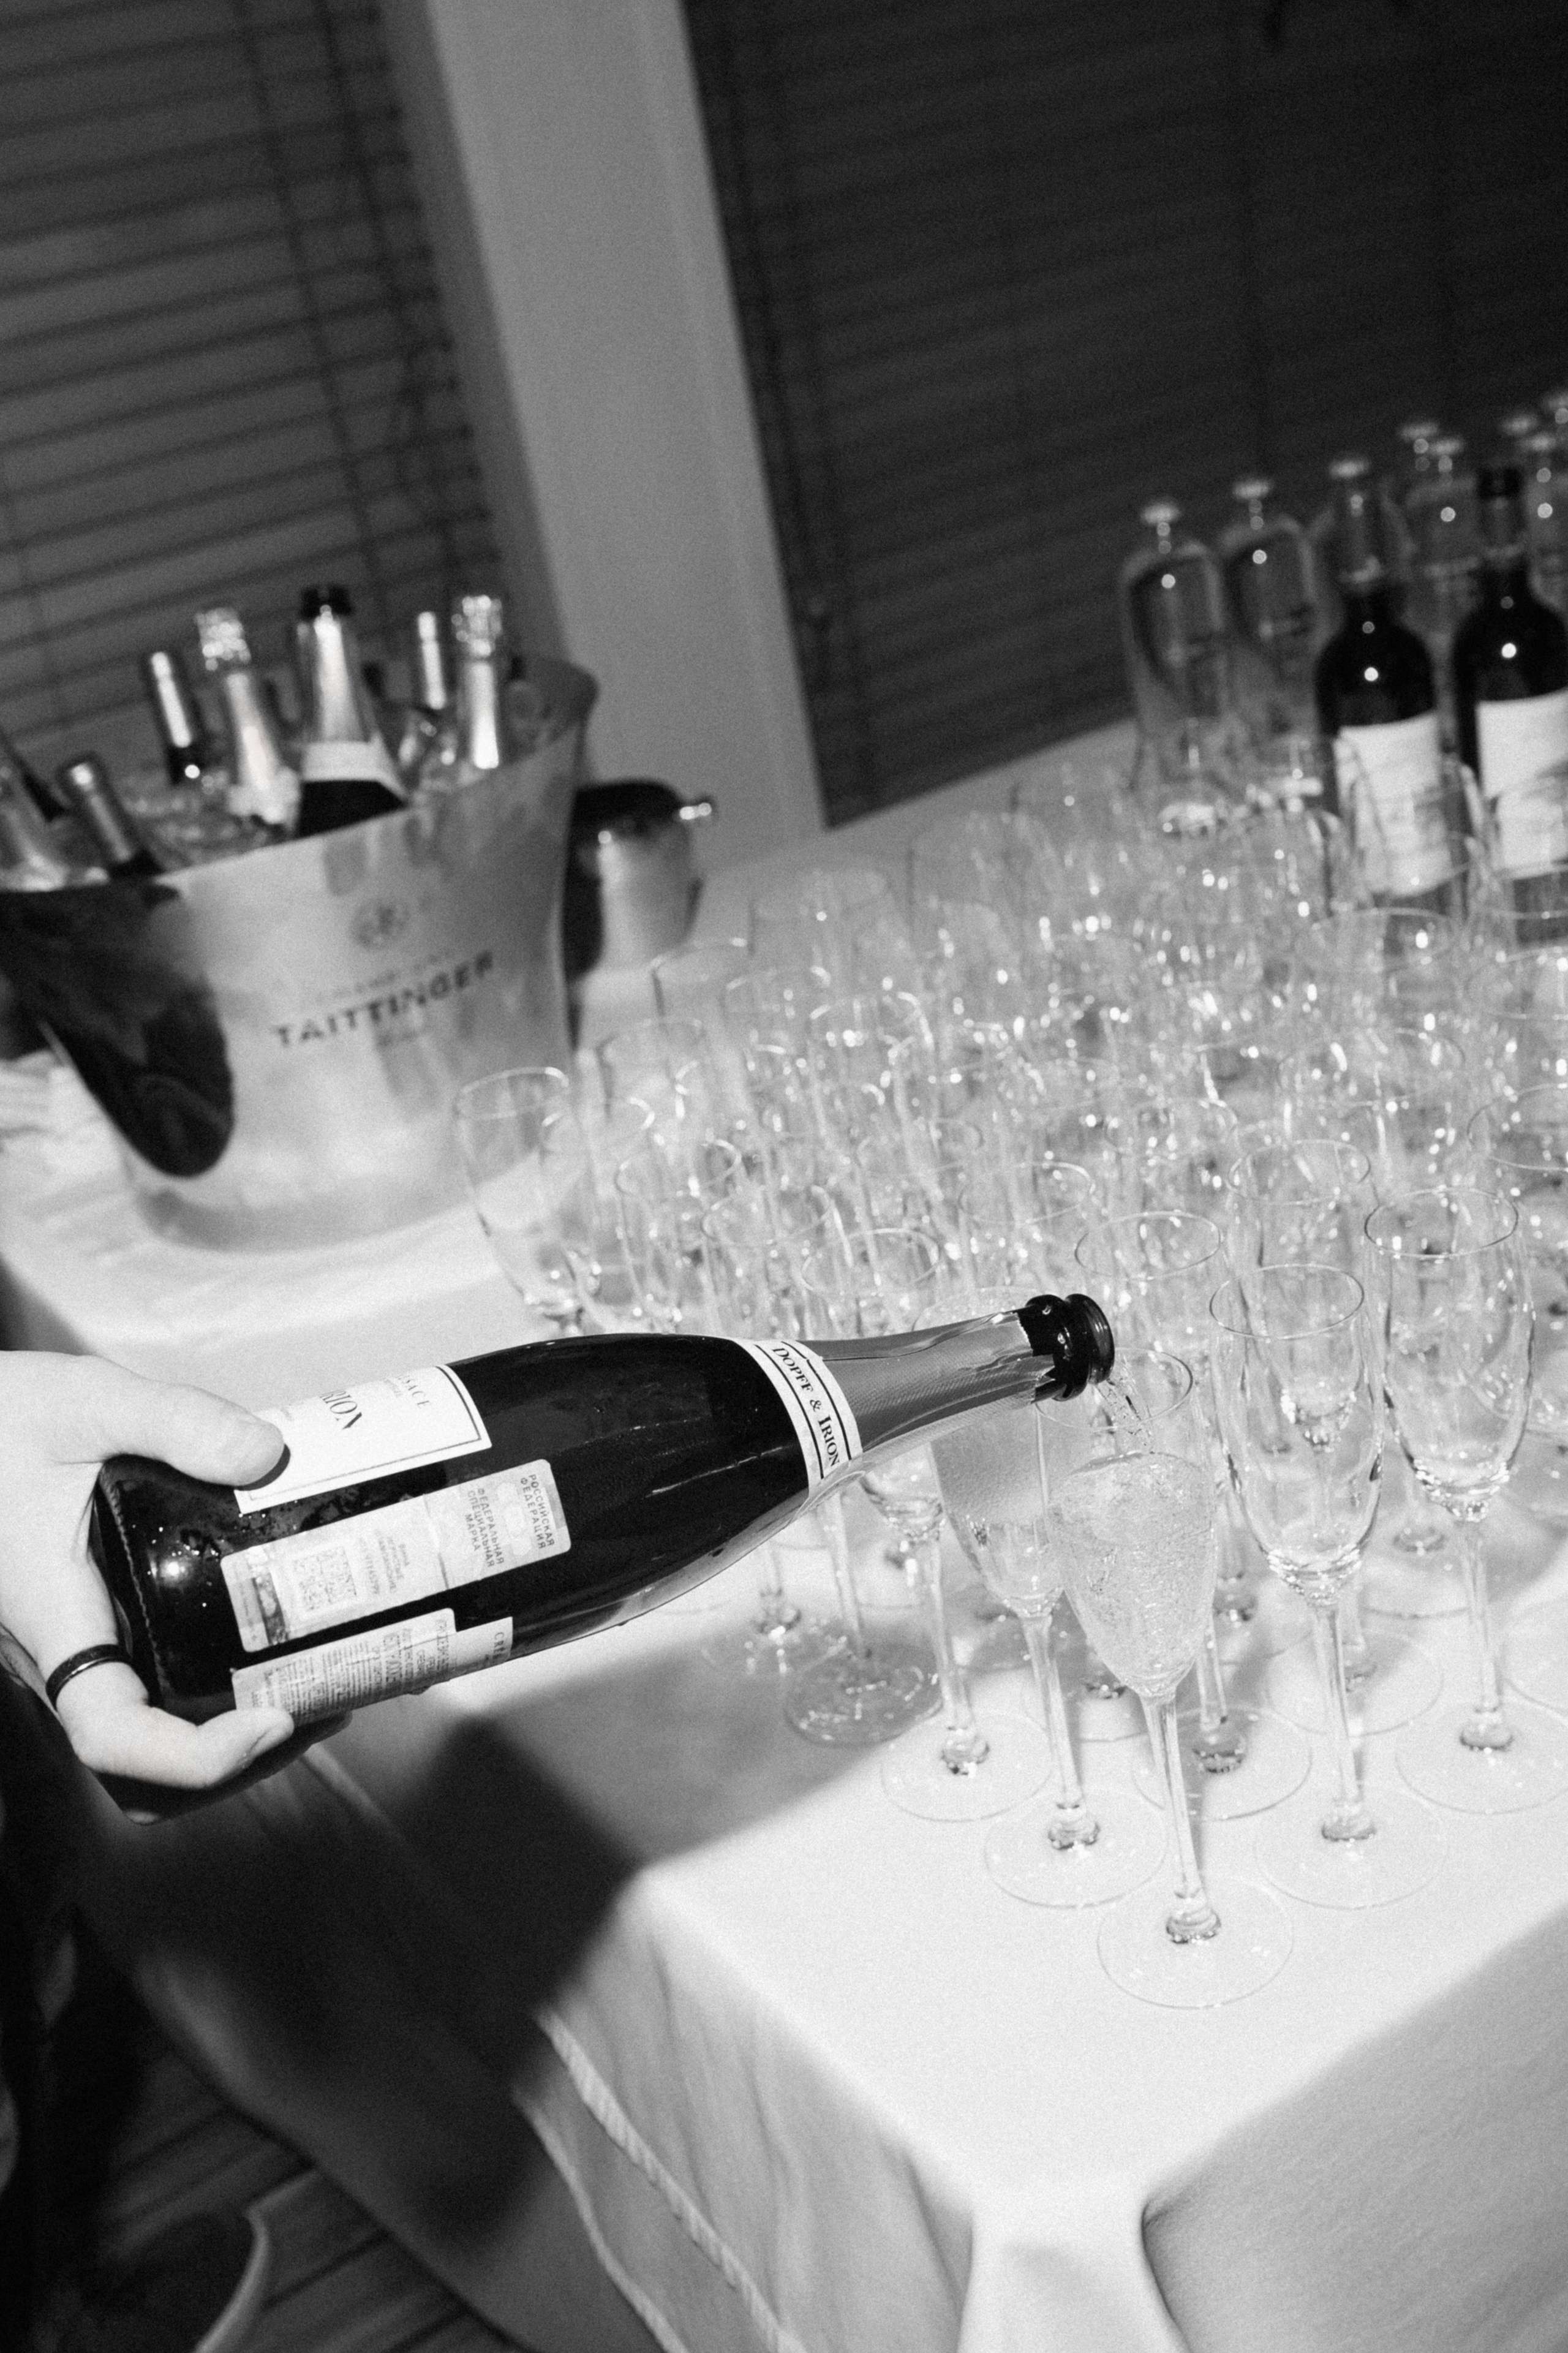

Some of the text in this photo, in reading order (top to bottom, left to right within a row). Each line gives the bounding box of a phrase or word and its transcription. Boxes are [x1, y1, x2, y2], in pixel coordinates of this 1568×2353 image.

[772, 1347, 840, 1467] DOPFF & IRION
[464, 1513, 481, 1552] МАРКА
[467, 1490, 495, 1568] СПЕЦИАЛЬНАЯ
[478, 1487, 505, 1565] ФЕДЕРАЛЬНАЯ
[520, 1477, 546, 1549] ФЕДЕРАЦИЯ
[528, 1473, 555, 1547] РОССИЙСКАЯ
